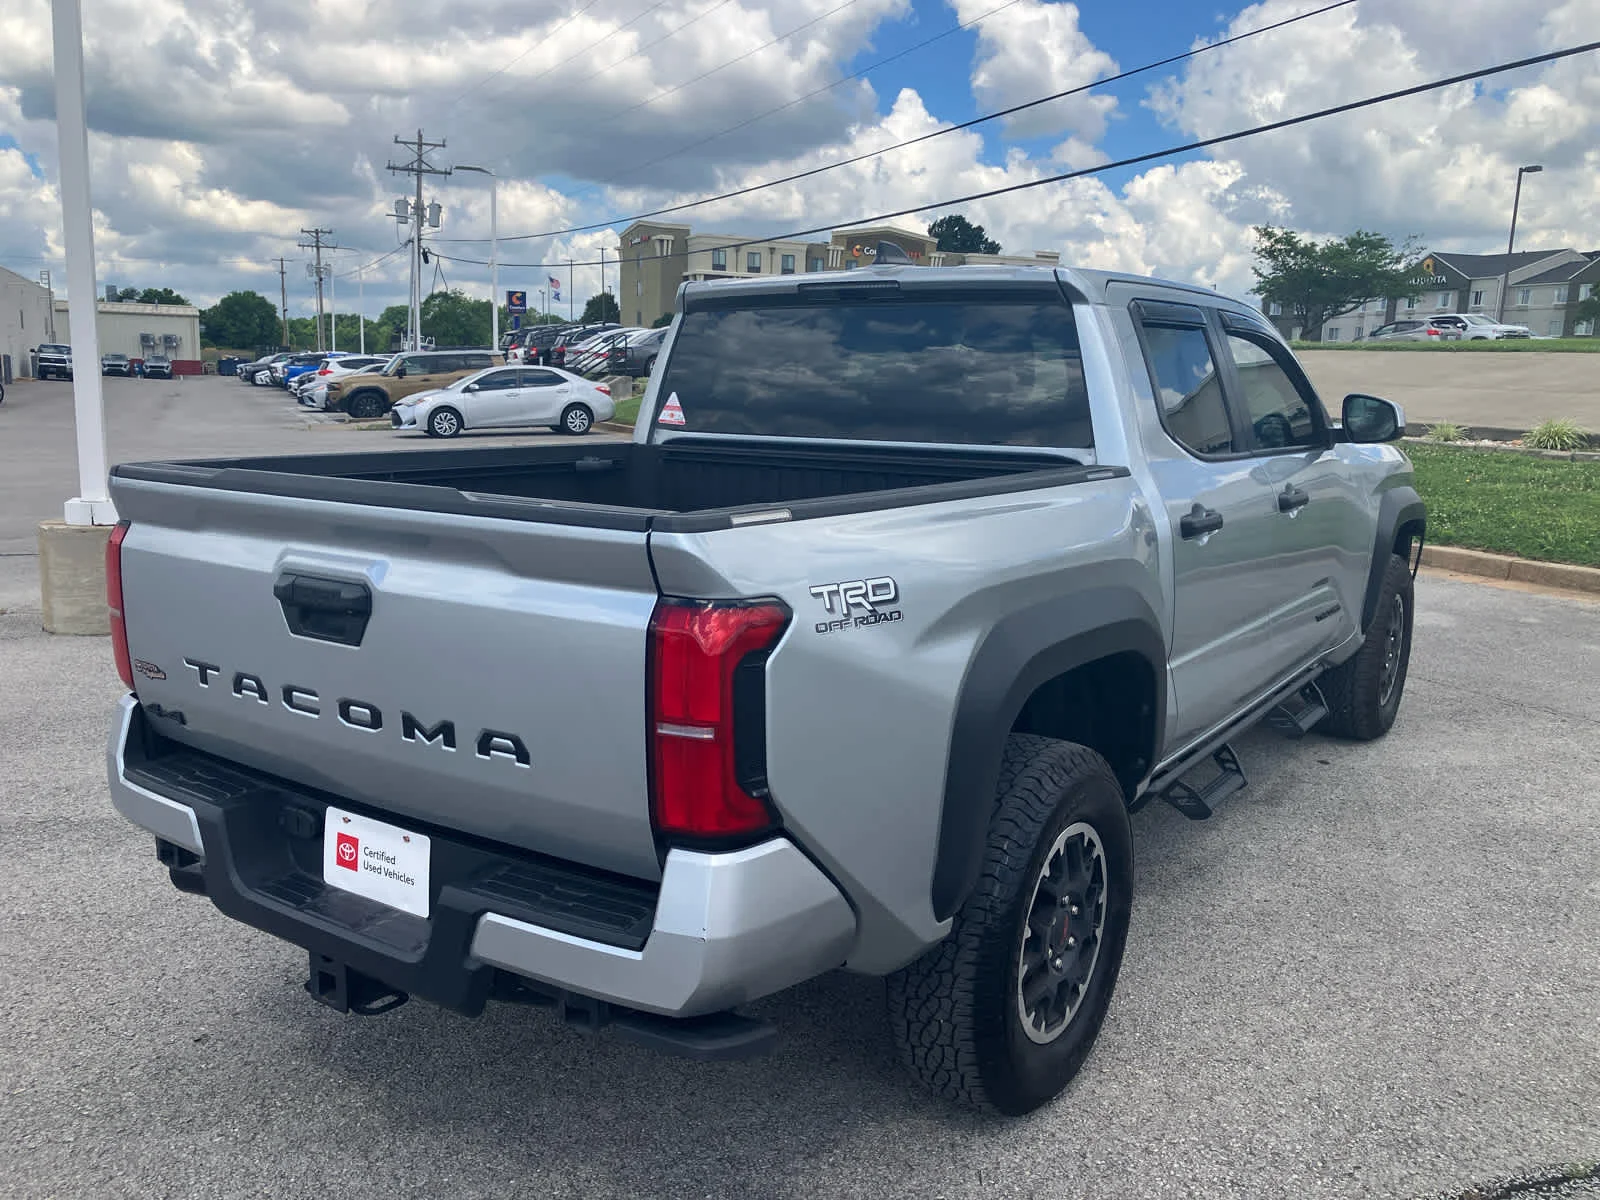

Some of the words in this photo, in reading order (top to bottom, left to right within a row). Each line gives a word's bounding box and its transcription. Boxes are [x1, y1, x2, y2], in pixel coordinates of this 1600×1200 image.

[809, 576, 898, 617] TRD
[815, 618, 852, 634] OFF
[854, 610, 904, 629] ROAD
[183, 656, 532, 769] TACOMA
[363, 846, 396, 865] Certified
[363, 860, 382, 875] Used
[383, 867, 415, 886] Vehicles
